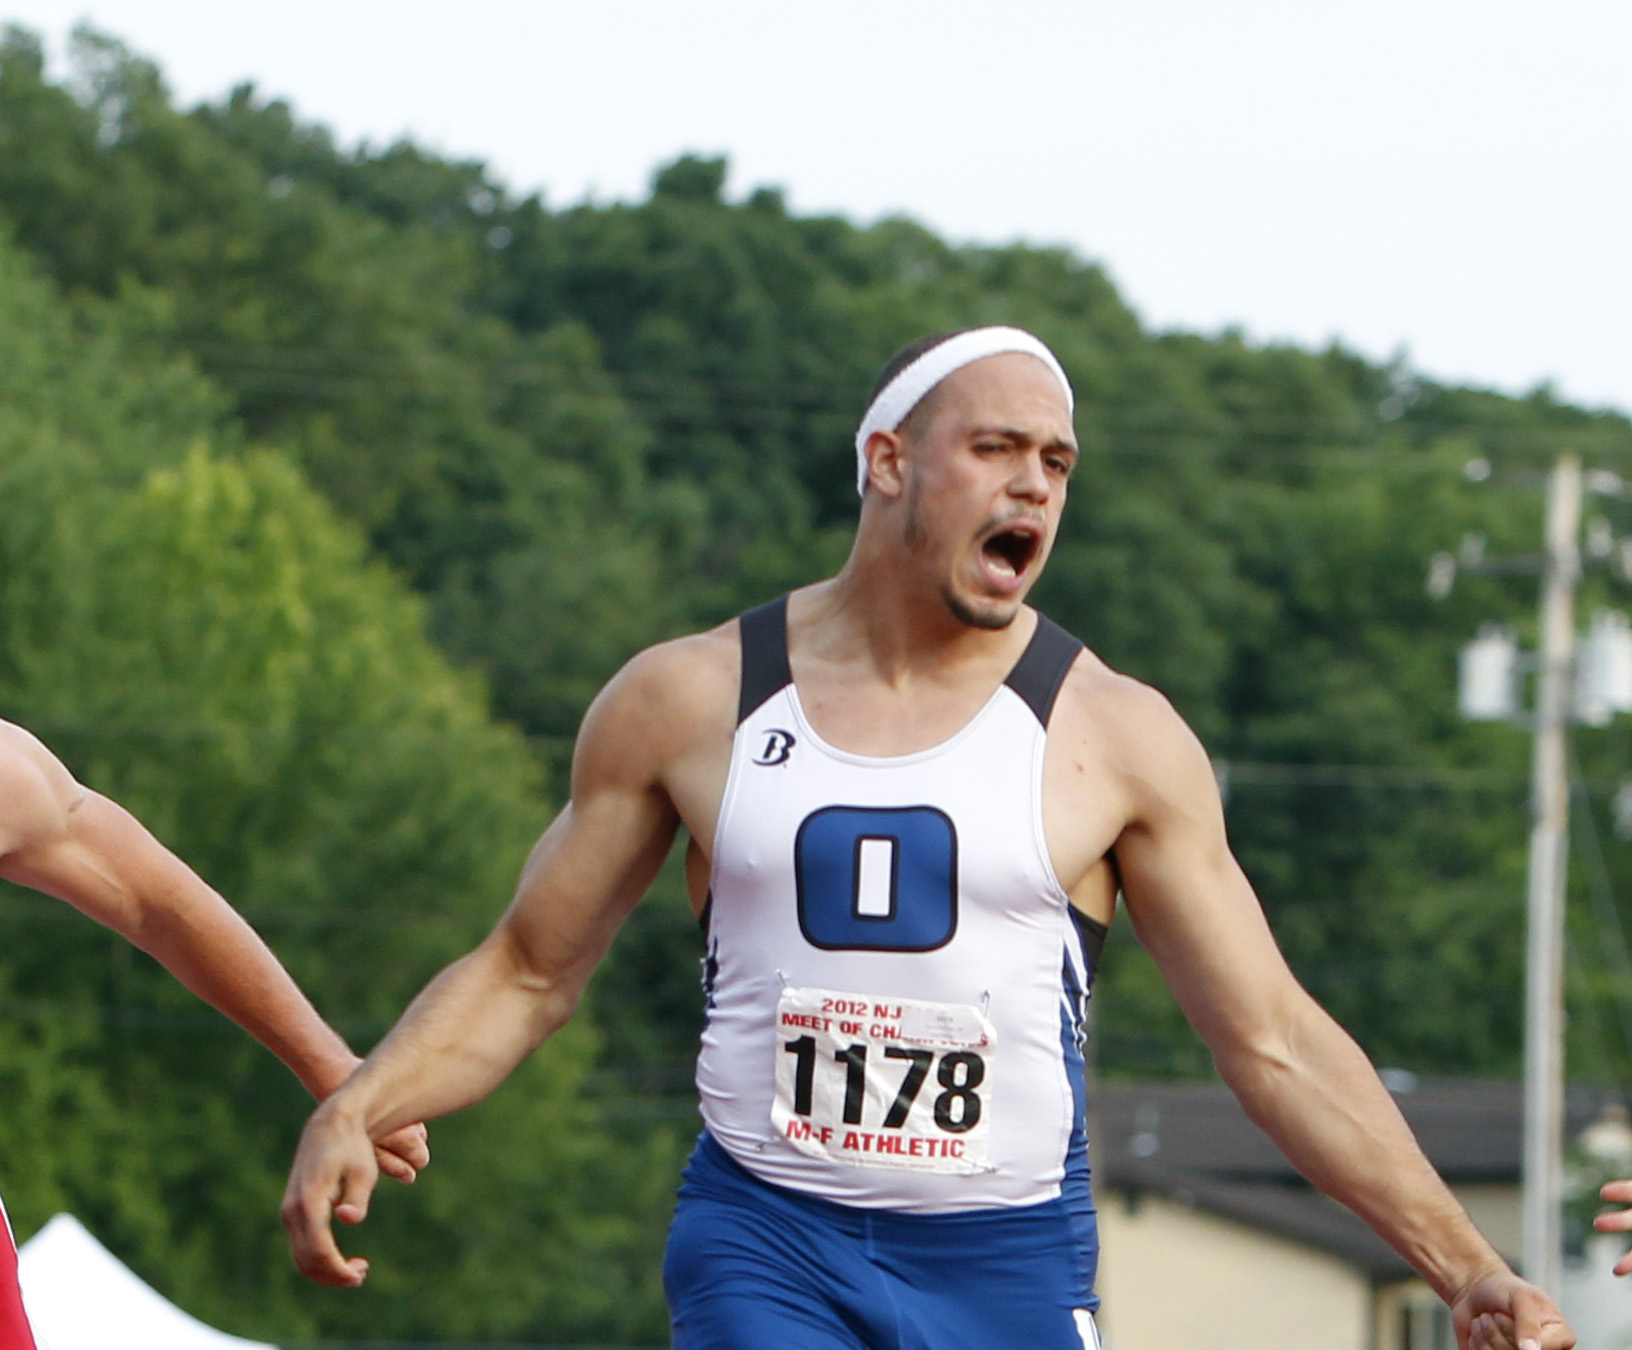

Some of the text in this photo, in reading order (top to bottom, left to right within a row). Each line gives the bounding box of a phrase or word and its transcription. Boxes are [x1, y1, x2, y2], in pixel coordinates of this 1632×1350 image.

[794, 805, 958, 952] O
[782, 1012, 863, 1034] MEET OF
[821, 998, 868, 1015] 2012
[784, 1035, 985, 1134] 1178
[786, 1120, 966, 1158] M-F ATHLETIC
